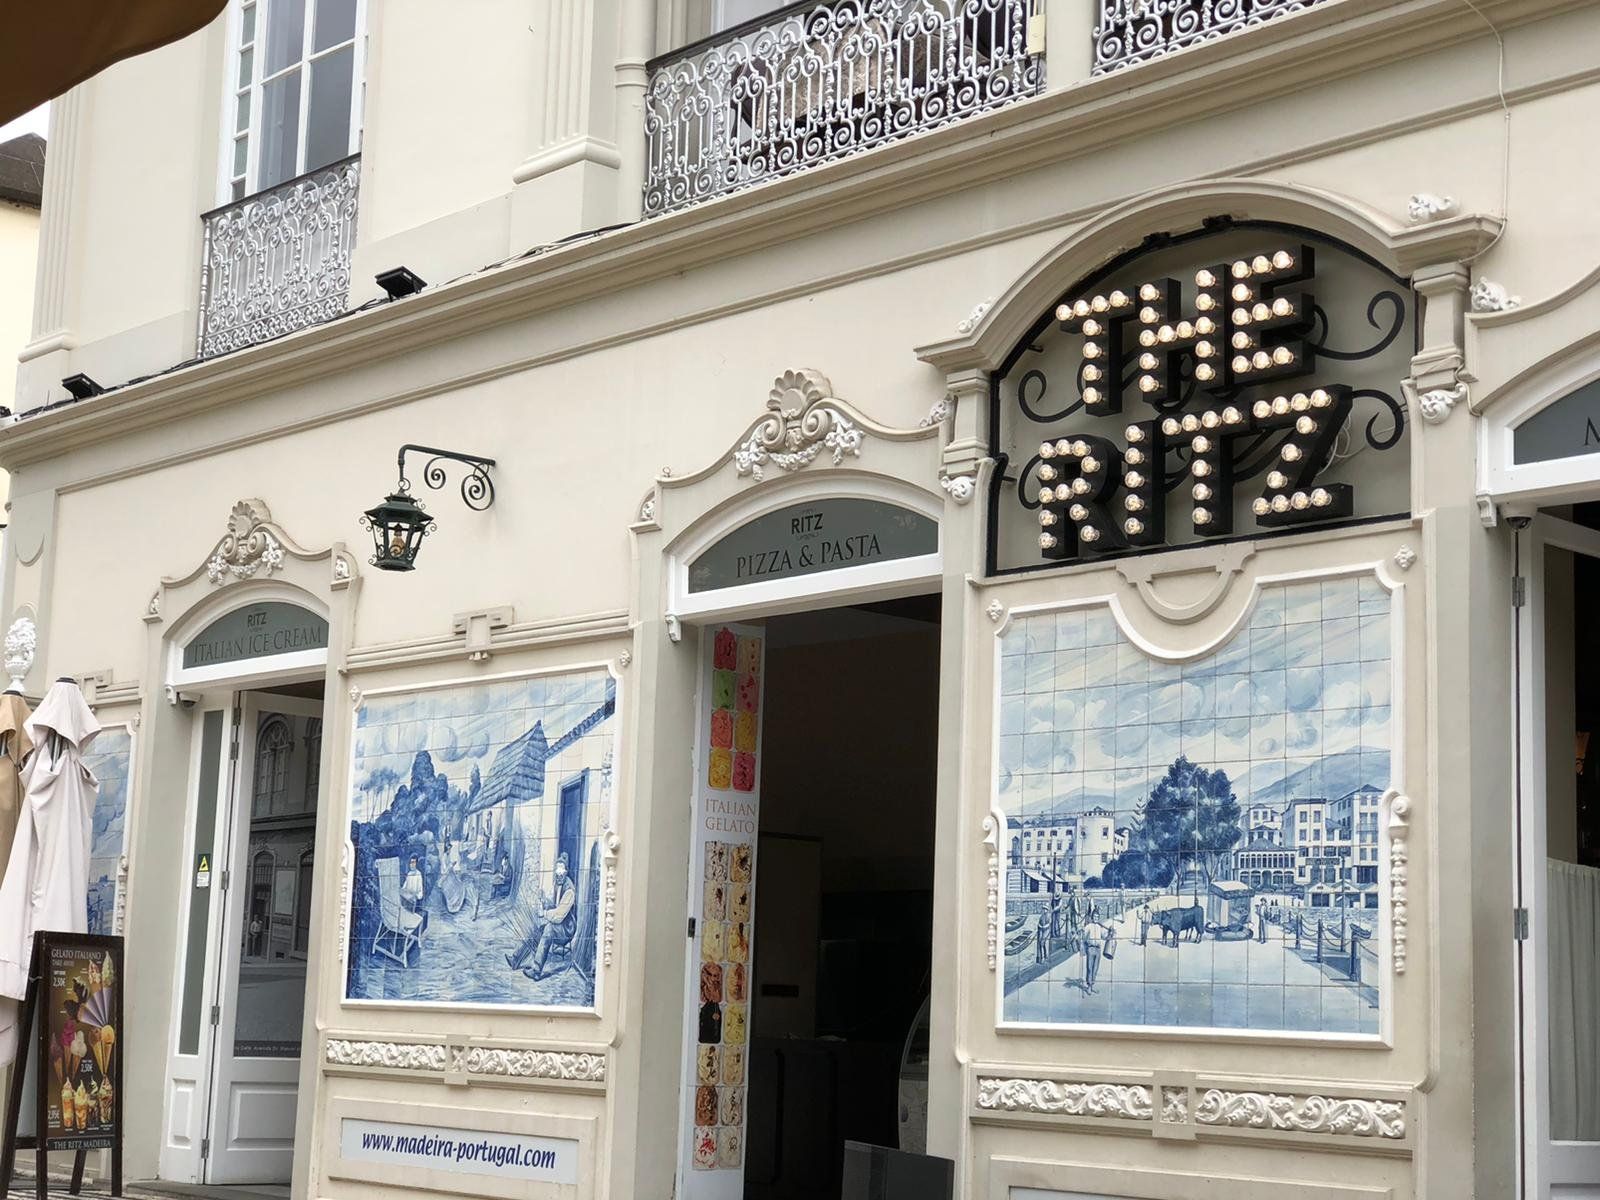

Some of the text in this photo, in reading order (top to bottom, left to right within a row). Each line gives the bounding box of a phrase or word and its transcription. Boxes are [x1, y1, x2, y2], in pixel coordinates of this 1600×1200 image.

[1056, 244, 1315, 416] THE
[1039, 384, 1354, 559] RITZ
[791, 513, 824, 535] RITZ
[736, 534, 882, 578] PIZZA & PASTA
[248, 612, 267, 628] RITZ
[194, 627, 321, 663] ITALIAN ICE CREAM
[705, 798, 756, 817] ITALIAN
[705, 816, 755, 834] GELATO
[51, 949, 102, 960] GELATO ITALIANO
[54, 1138, 111, 1150] THE RITZ MADEIRA
[362, 1132, 556, 1169] www.madeira-portugal.com
